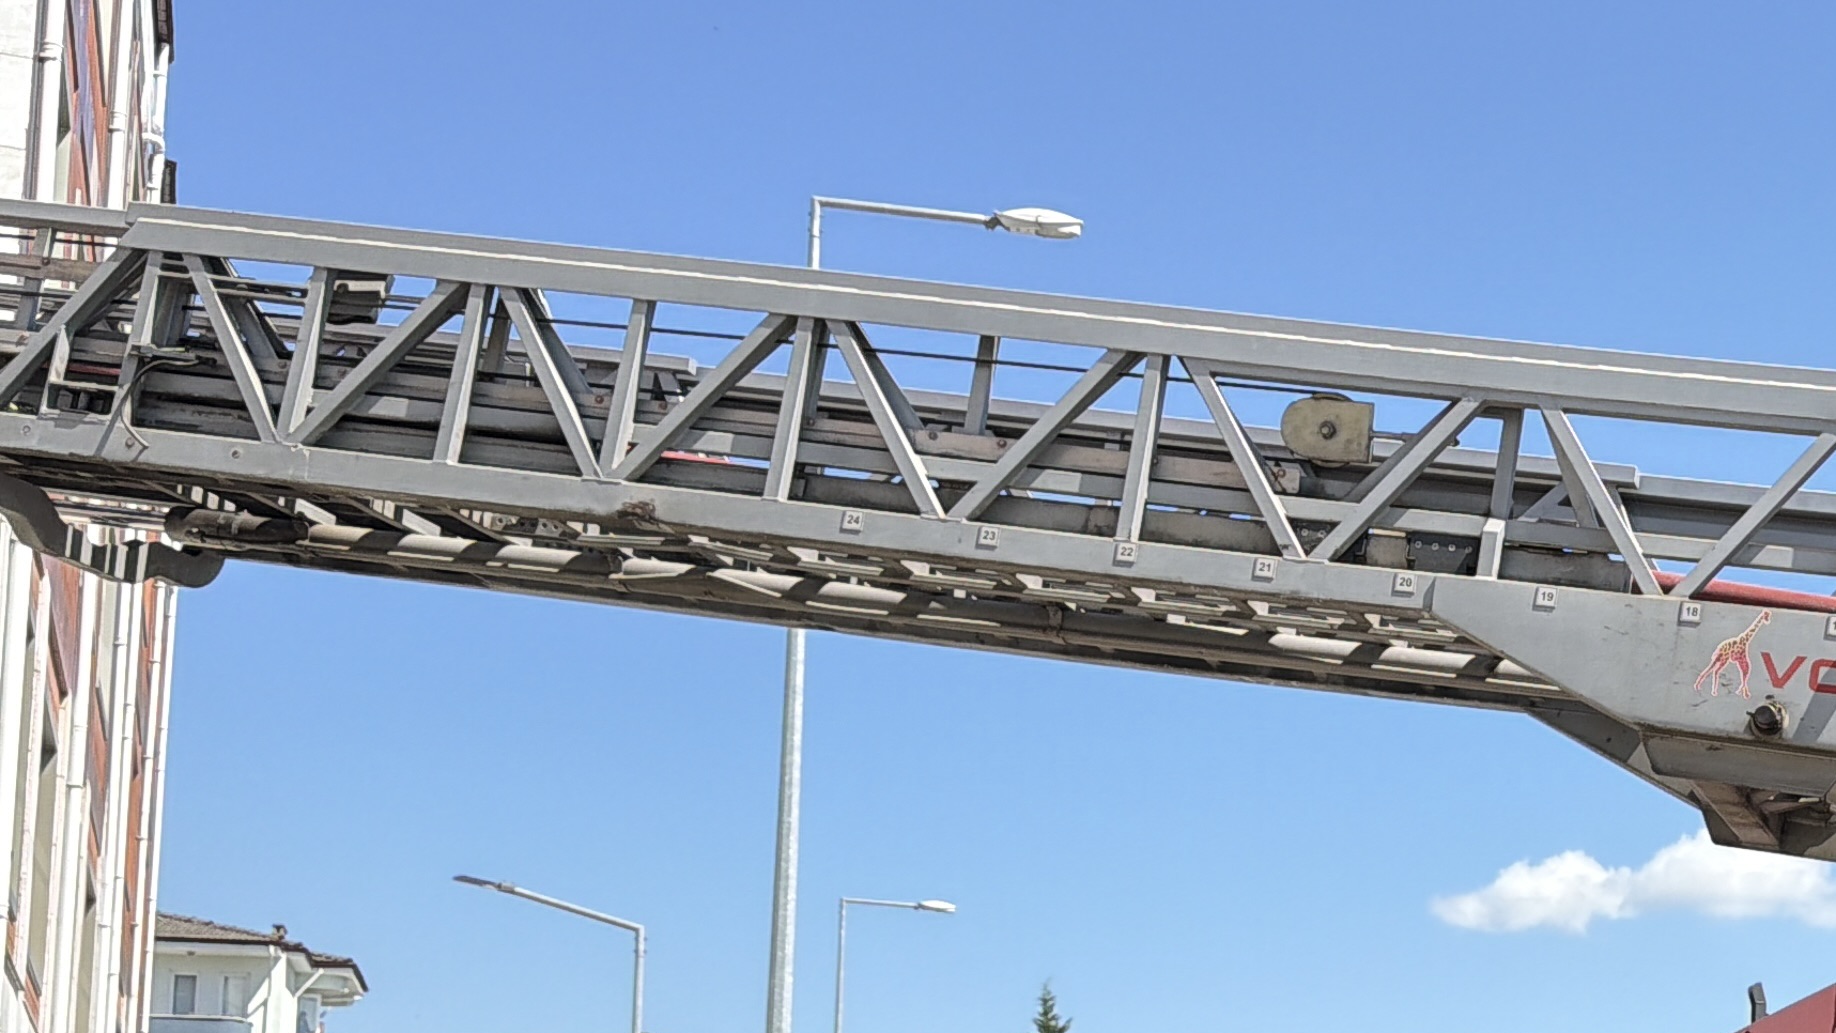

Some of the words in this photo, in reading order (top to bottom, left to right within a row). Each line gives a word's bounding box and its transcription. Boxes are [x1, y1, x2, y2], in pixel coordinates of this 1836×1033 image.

[846, 514, 860, 526] 24
[982, 530, 996, 542] 23
[1120, 545, 1134, 557] 22
[1258, 561, 1272, 573] 21
[1398, 577, 1413, 588] 20
[1540, 591, 1554, 602] 19
[1685, 606, 1699, 618] 18
